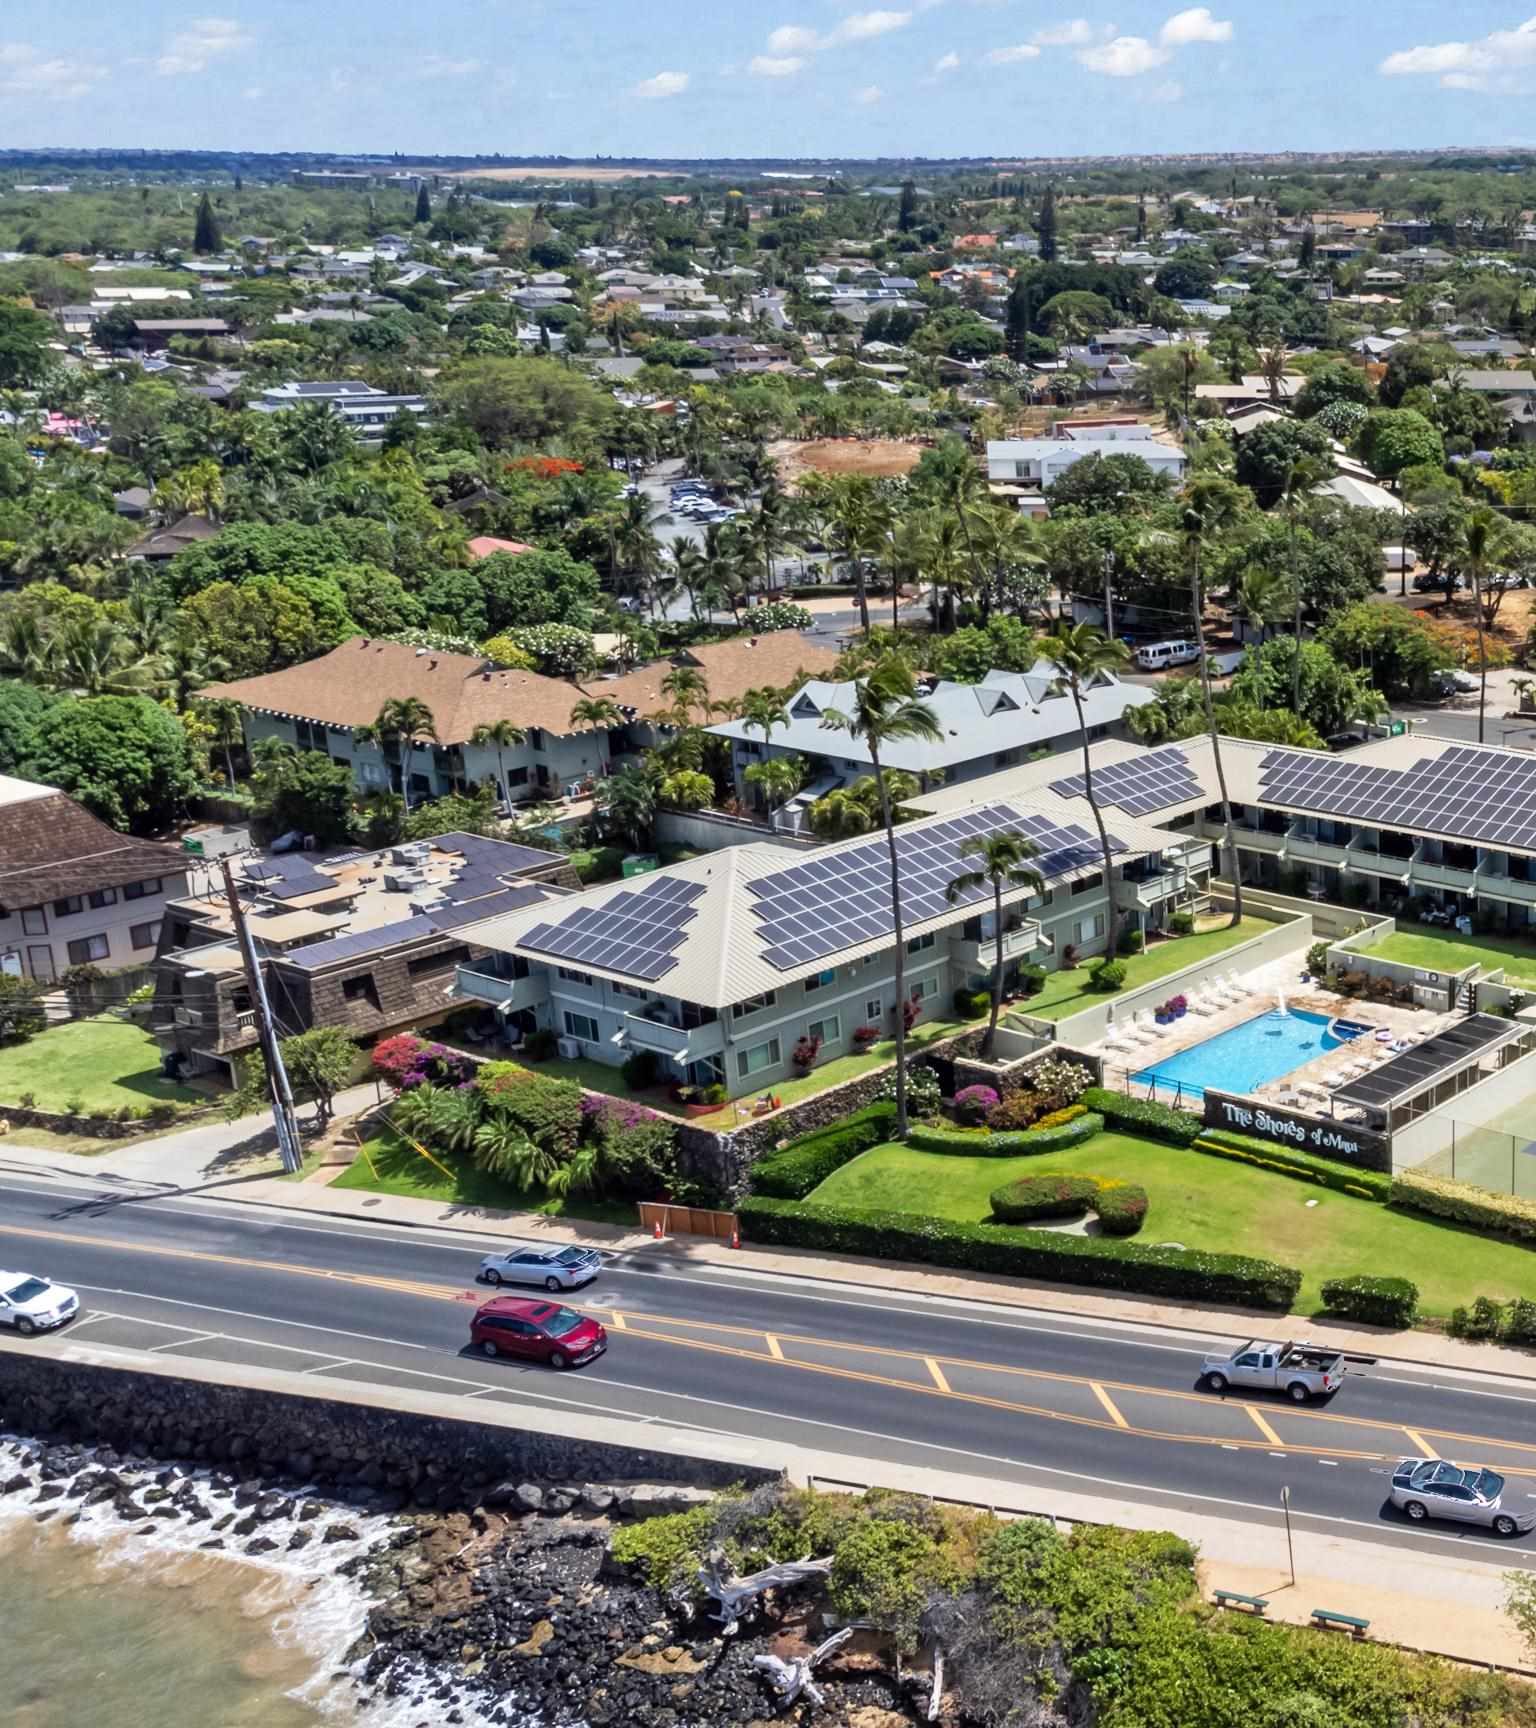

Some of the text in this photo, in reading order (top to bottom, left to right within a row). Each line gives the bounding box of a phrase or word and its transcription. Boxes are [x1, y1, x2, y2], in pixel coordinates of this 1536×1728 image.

[1222, 1102, 1358, 1154] The Shores of Maui
